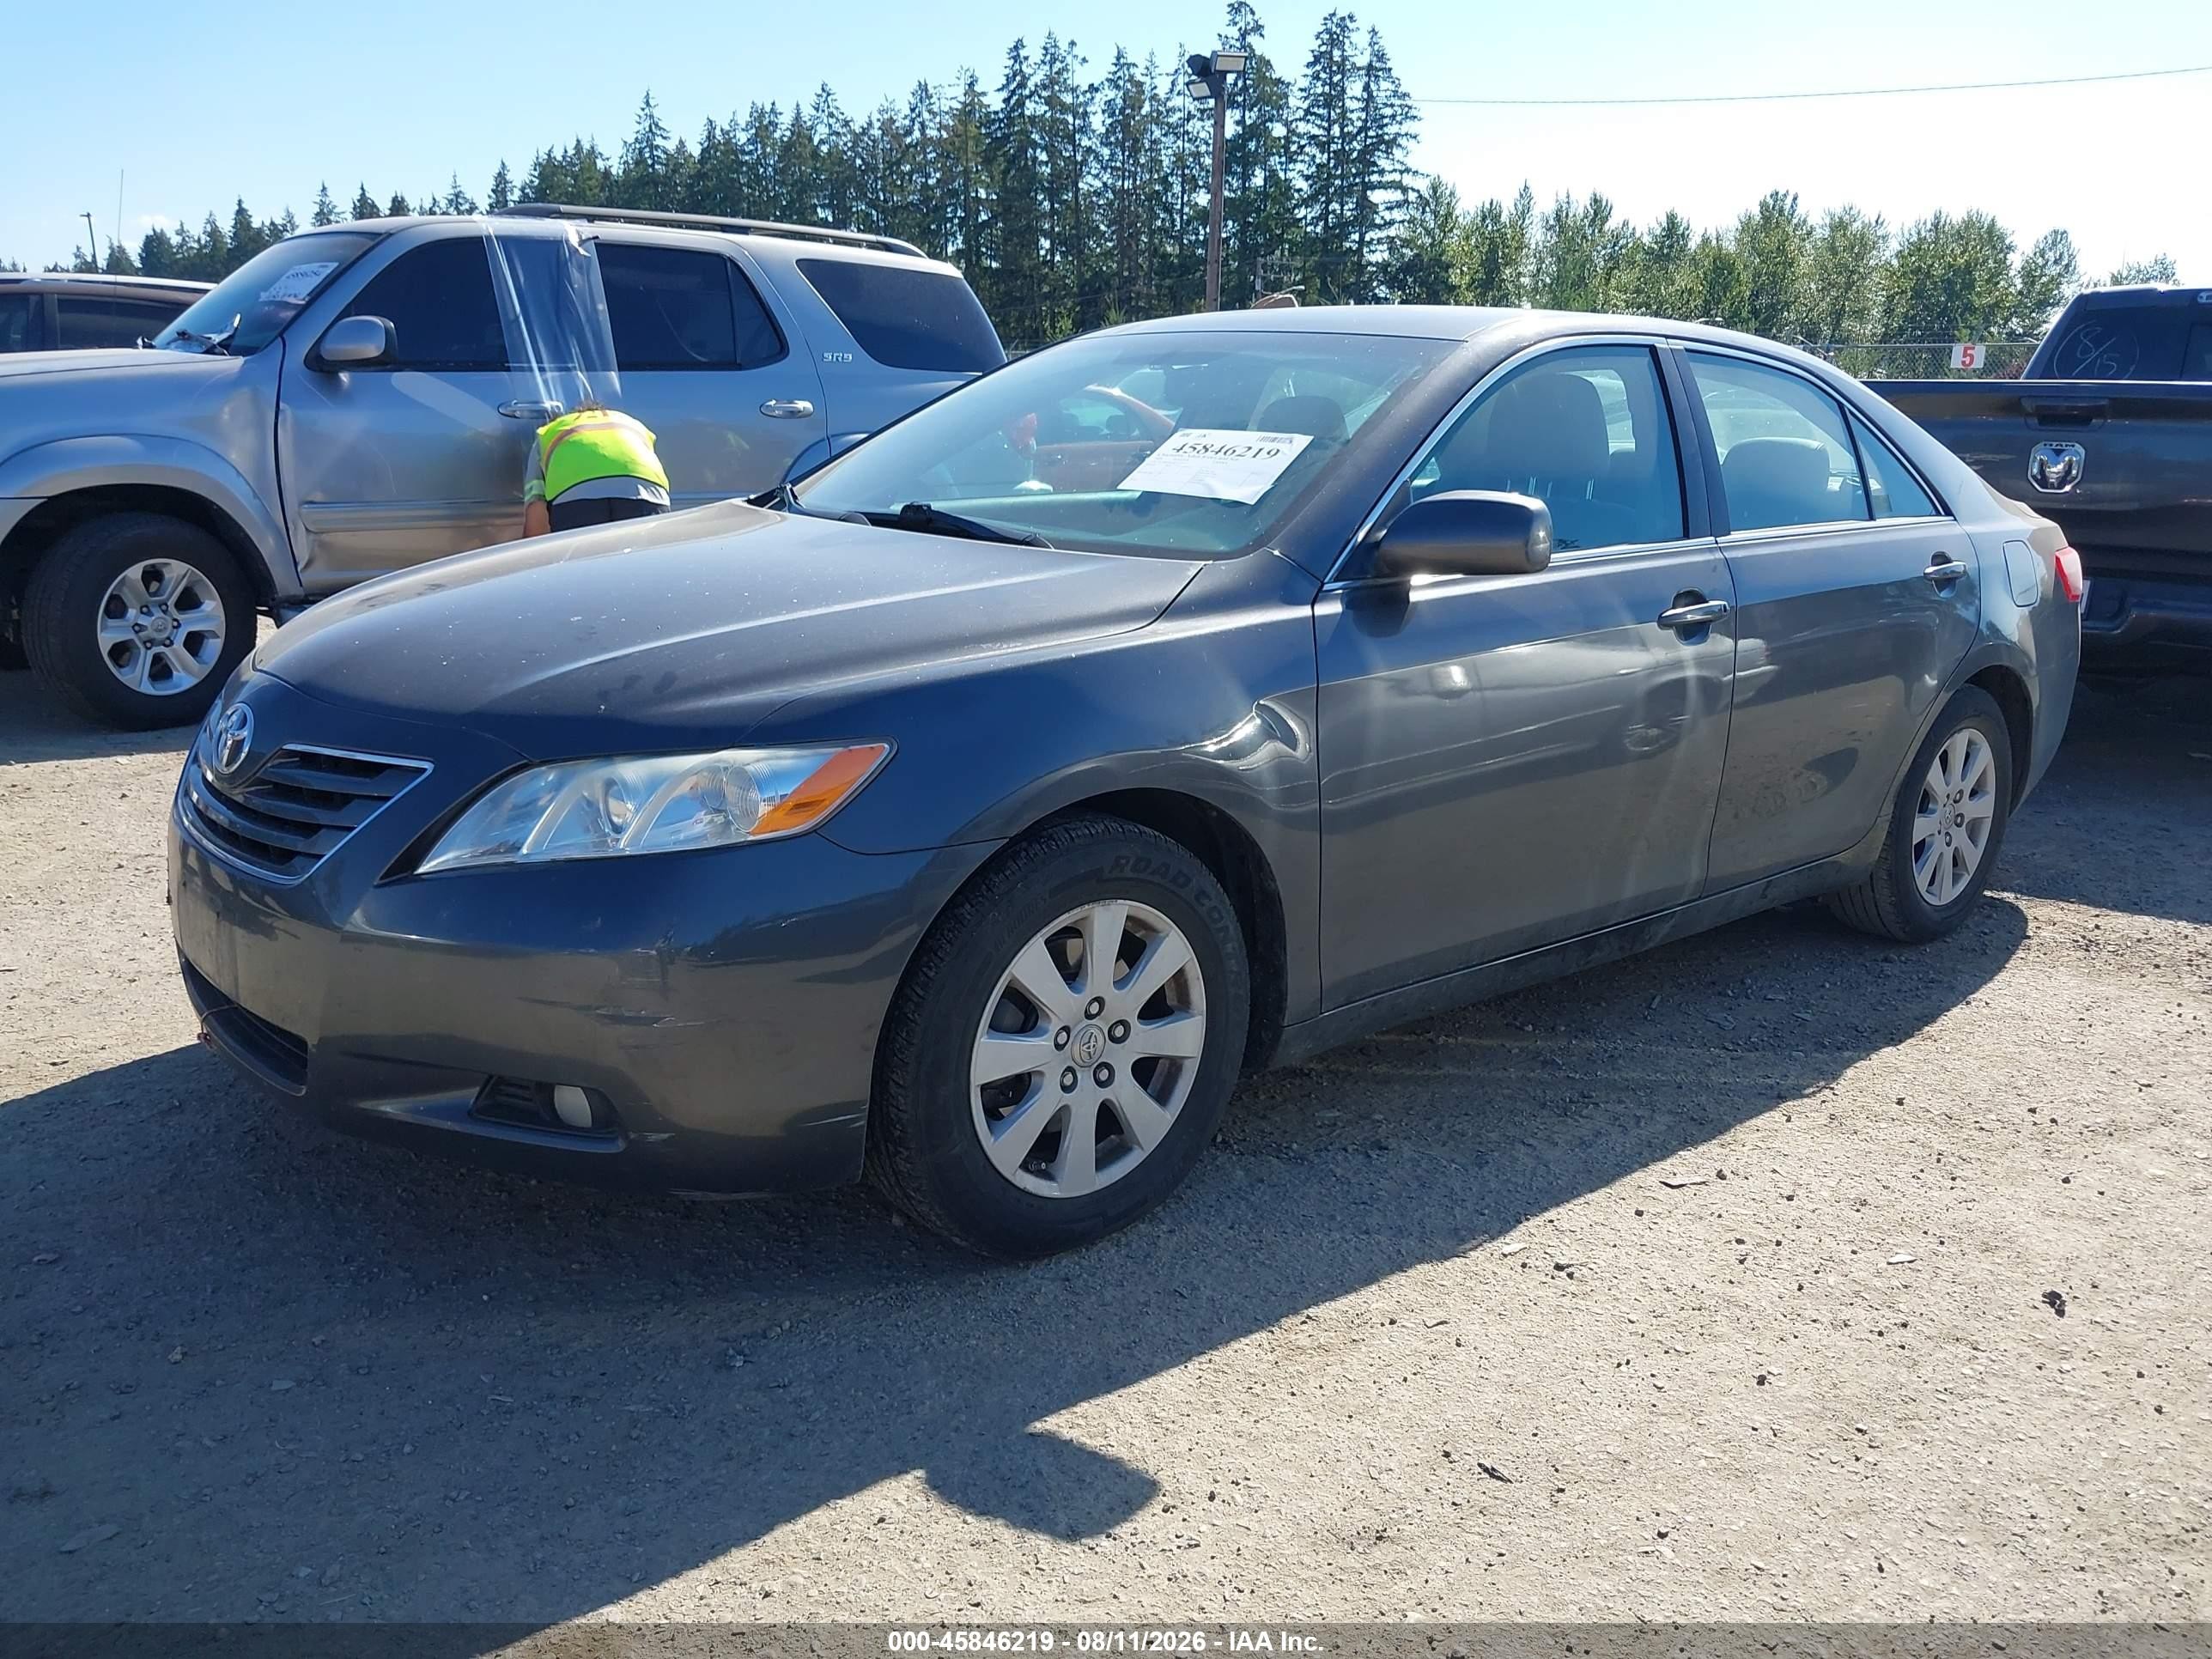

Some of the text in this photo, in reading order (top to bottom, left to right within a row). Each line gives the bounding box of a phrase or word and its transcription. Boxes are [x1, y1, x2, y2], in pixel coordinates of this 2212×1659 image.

[1960, 344, 1976, 368] 5
[1172, 442, 1280, 460] 45846219
[1109, 855, 1192, 889] ROAD
